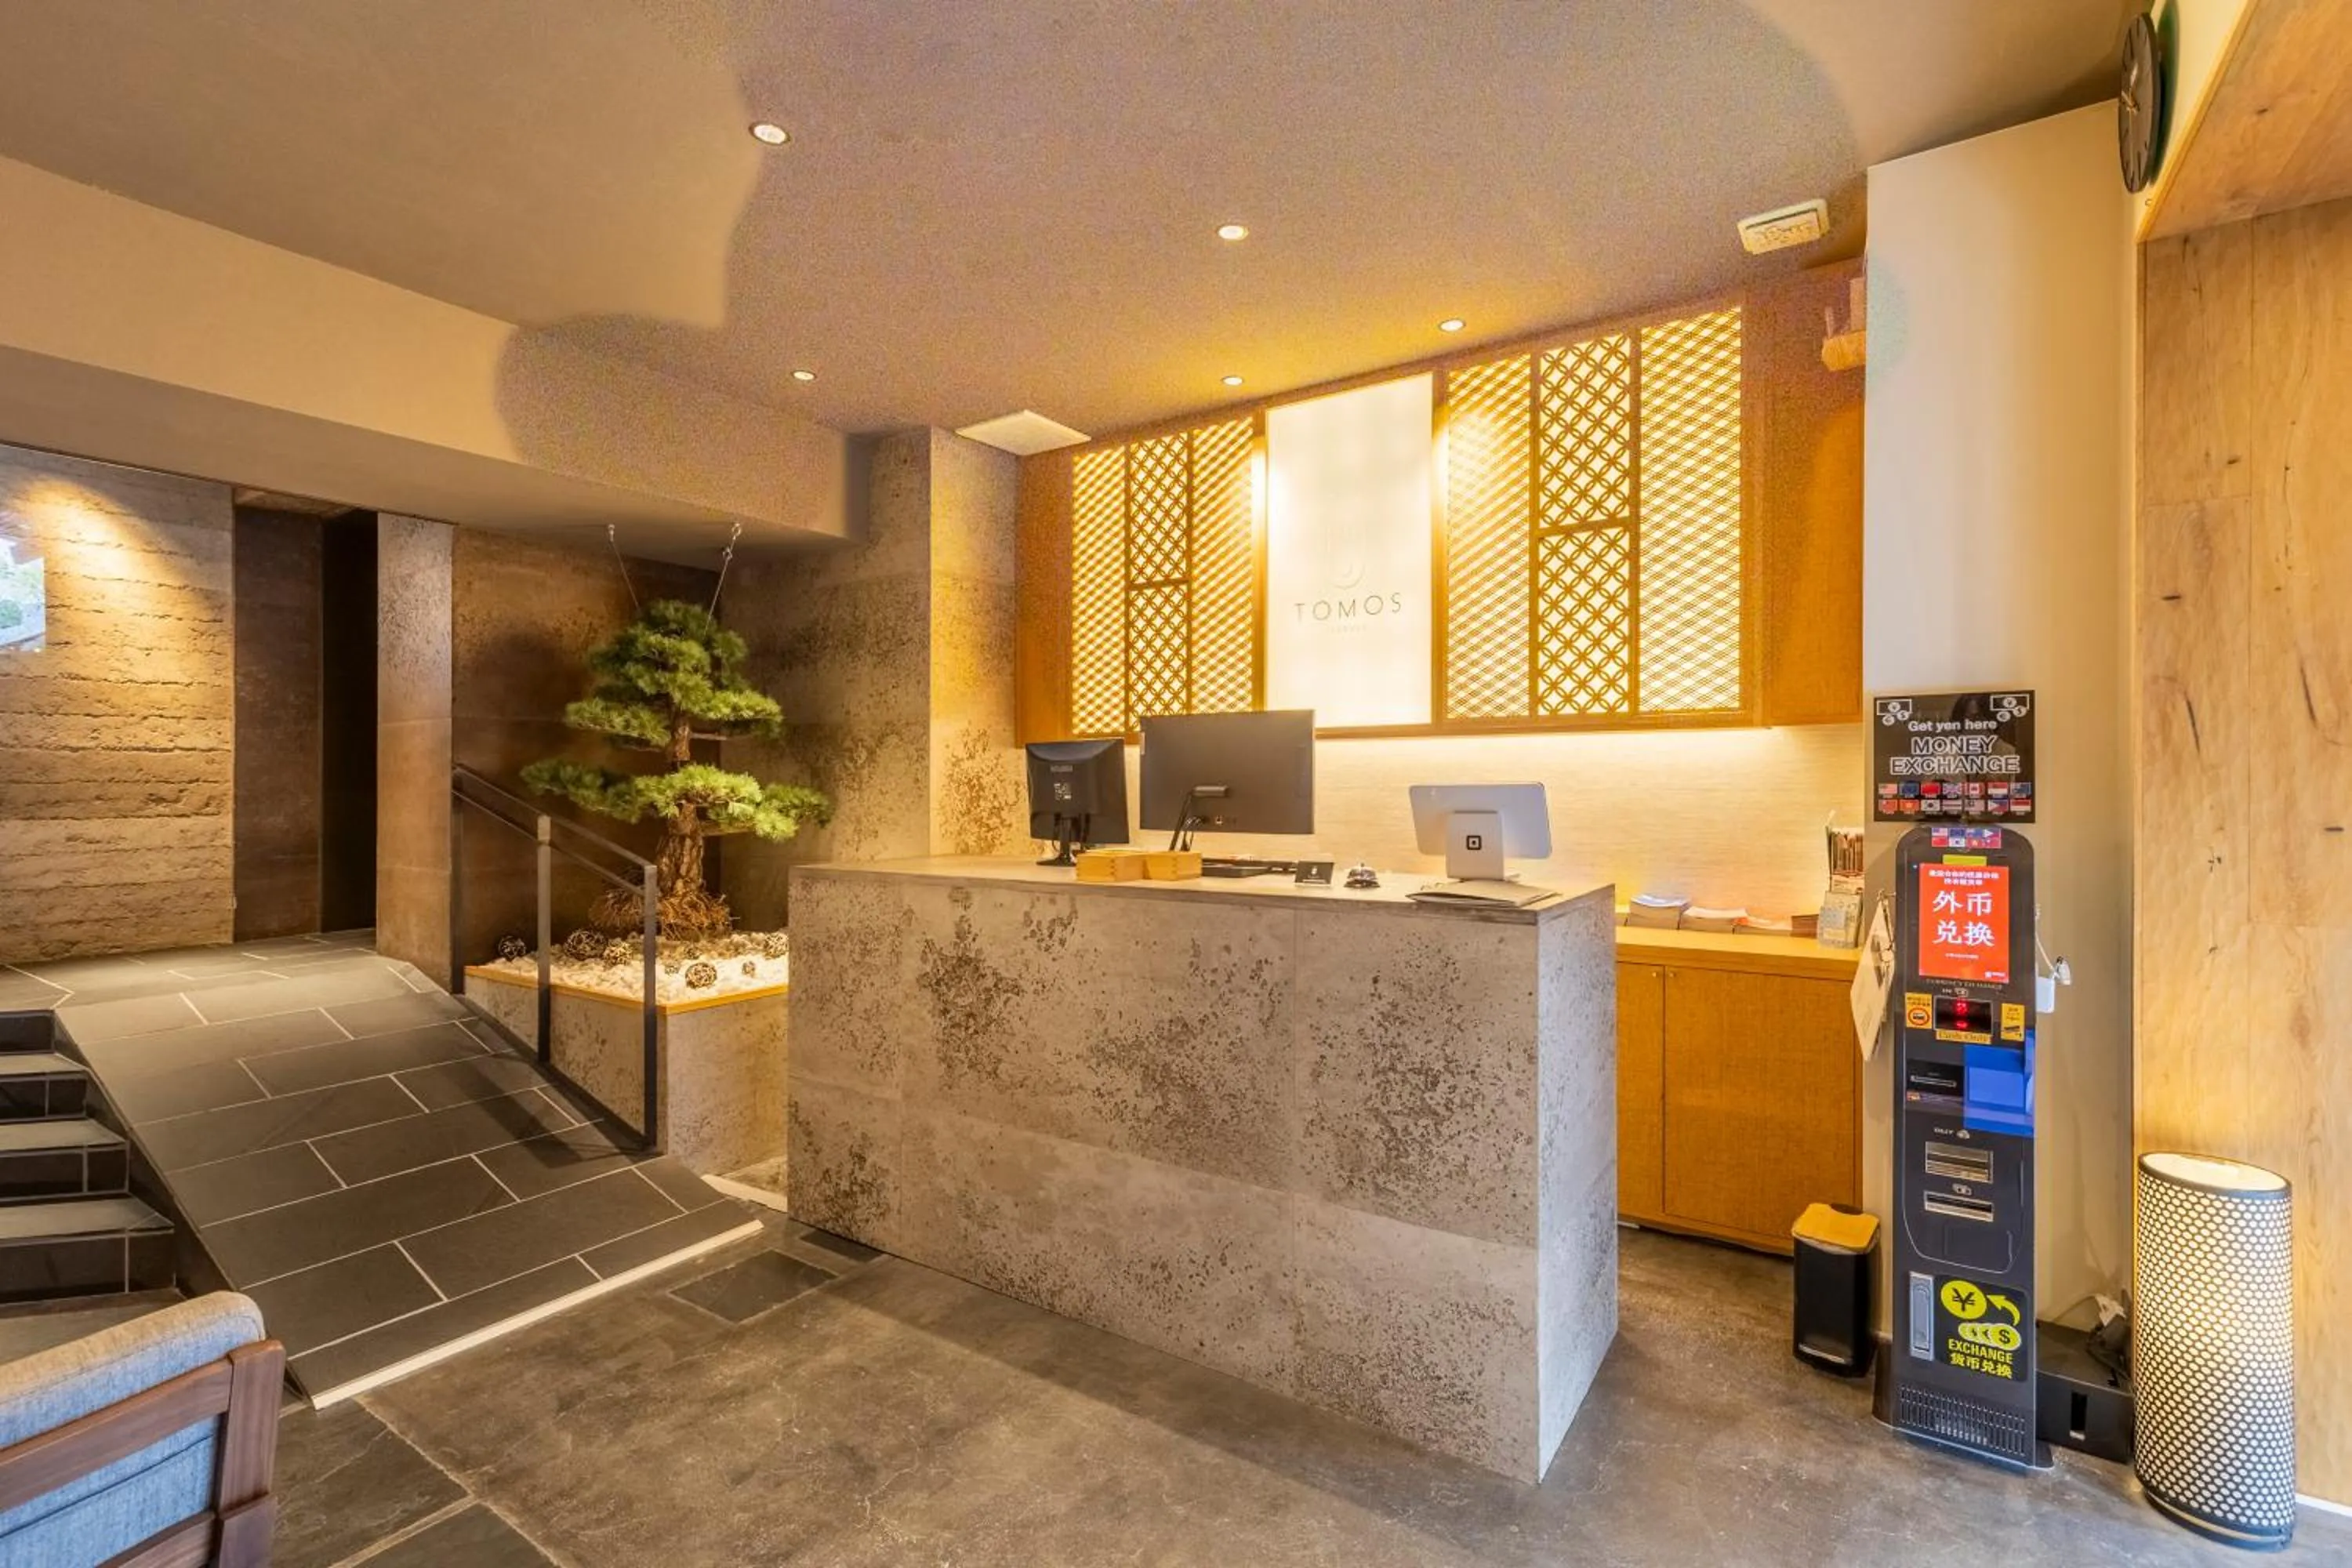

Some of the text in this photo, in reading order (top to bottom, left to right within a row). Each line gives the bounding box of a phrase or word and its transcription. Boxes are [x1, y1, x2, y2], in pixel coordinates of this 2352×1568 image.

[1294, 592, 1402, 622] TOMOS
[1908, 719, 1998, 733] Get yen here
[1911, 735, 1998, 755] MONEY
[1890, 755, 2020, 775] EXCHANGE
[1932, 890, 1993, 916] 外币
[1932, 919, 1995, 947] 兑换
[1948, 1338, 2013, 1364] EXCHANGE
